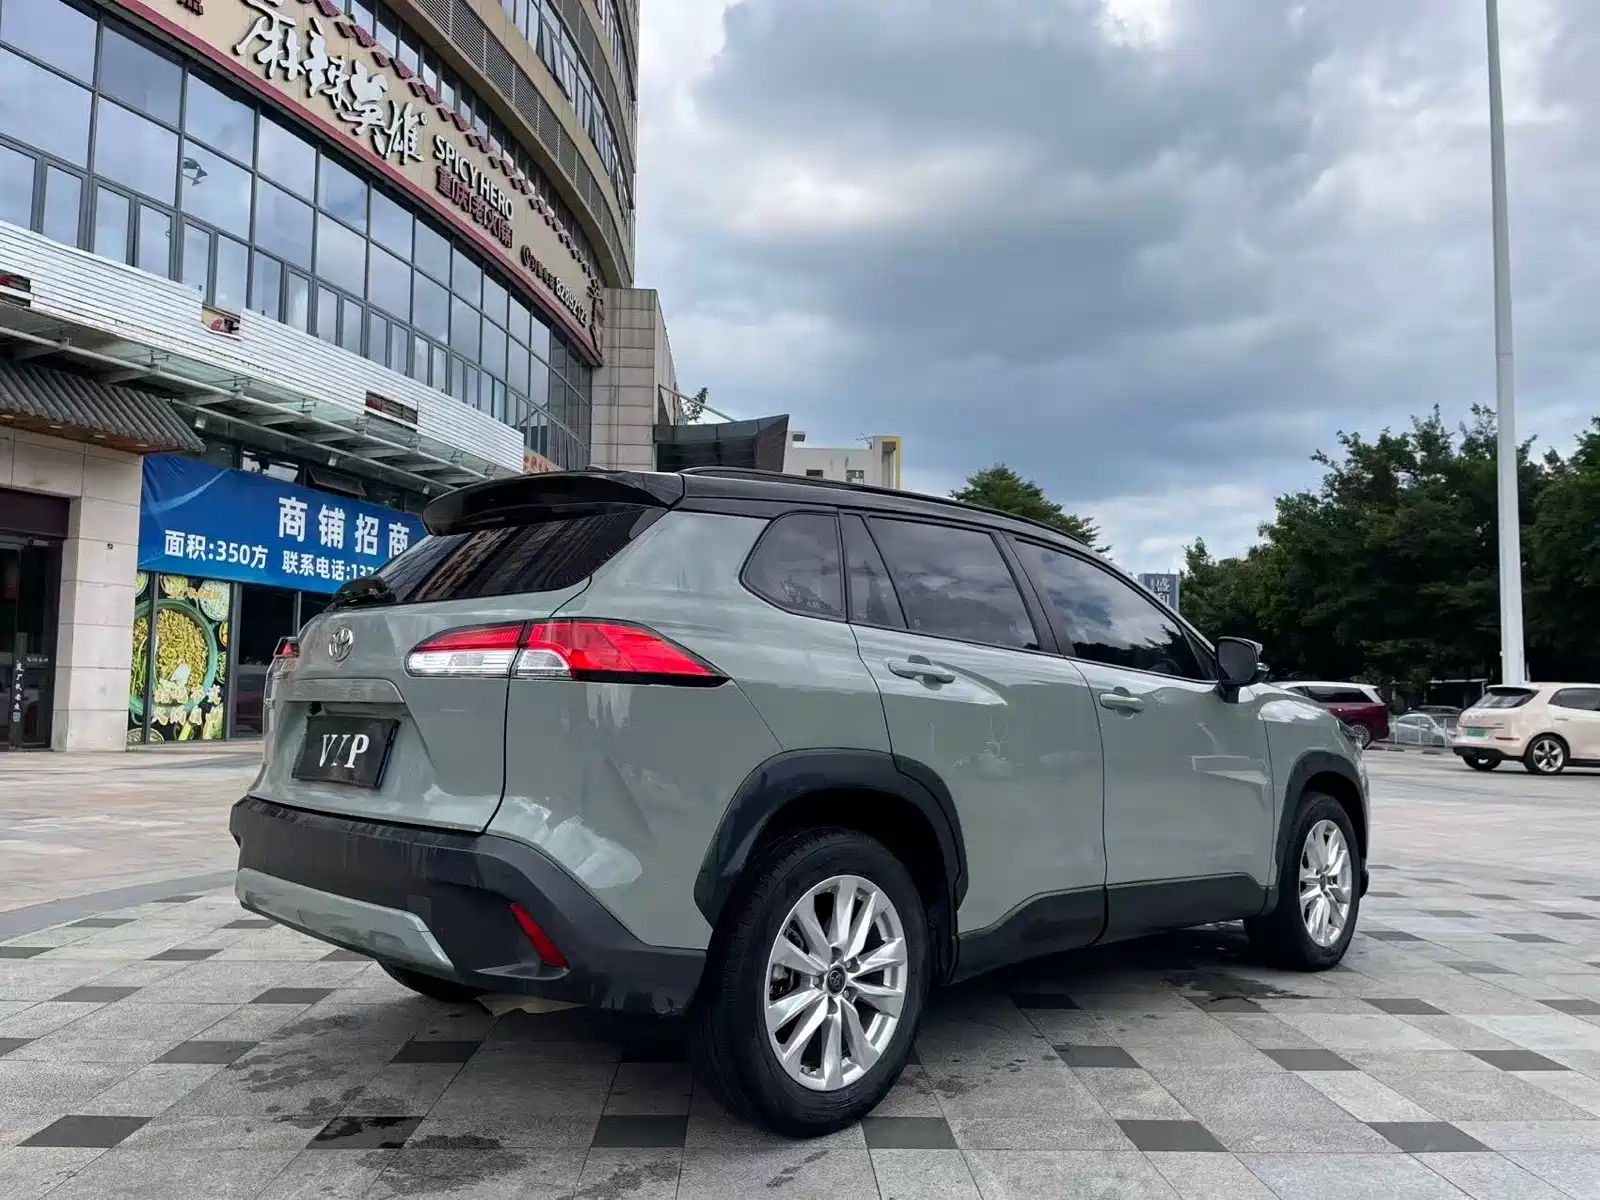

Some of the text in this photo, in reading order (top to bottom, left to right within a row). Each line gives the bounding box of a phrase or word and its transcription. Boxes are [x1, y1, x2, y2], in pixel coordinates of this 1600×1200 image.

[433, 134, 515, 221] SPICY HERO
[164, 529, 379, 582] 面积:350方 联系电话:137
[278, 496, 410, 559] 商铺招商
[319, 733, 370, 769] VIP
